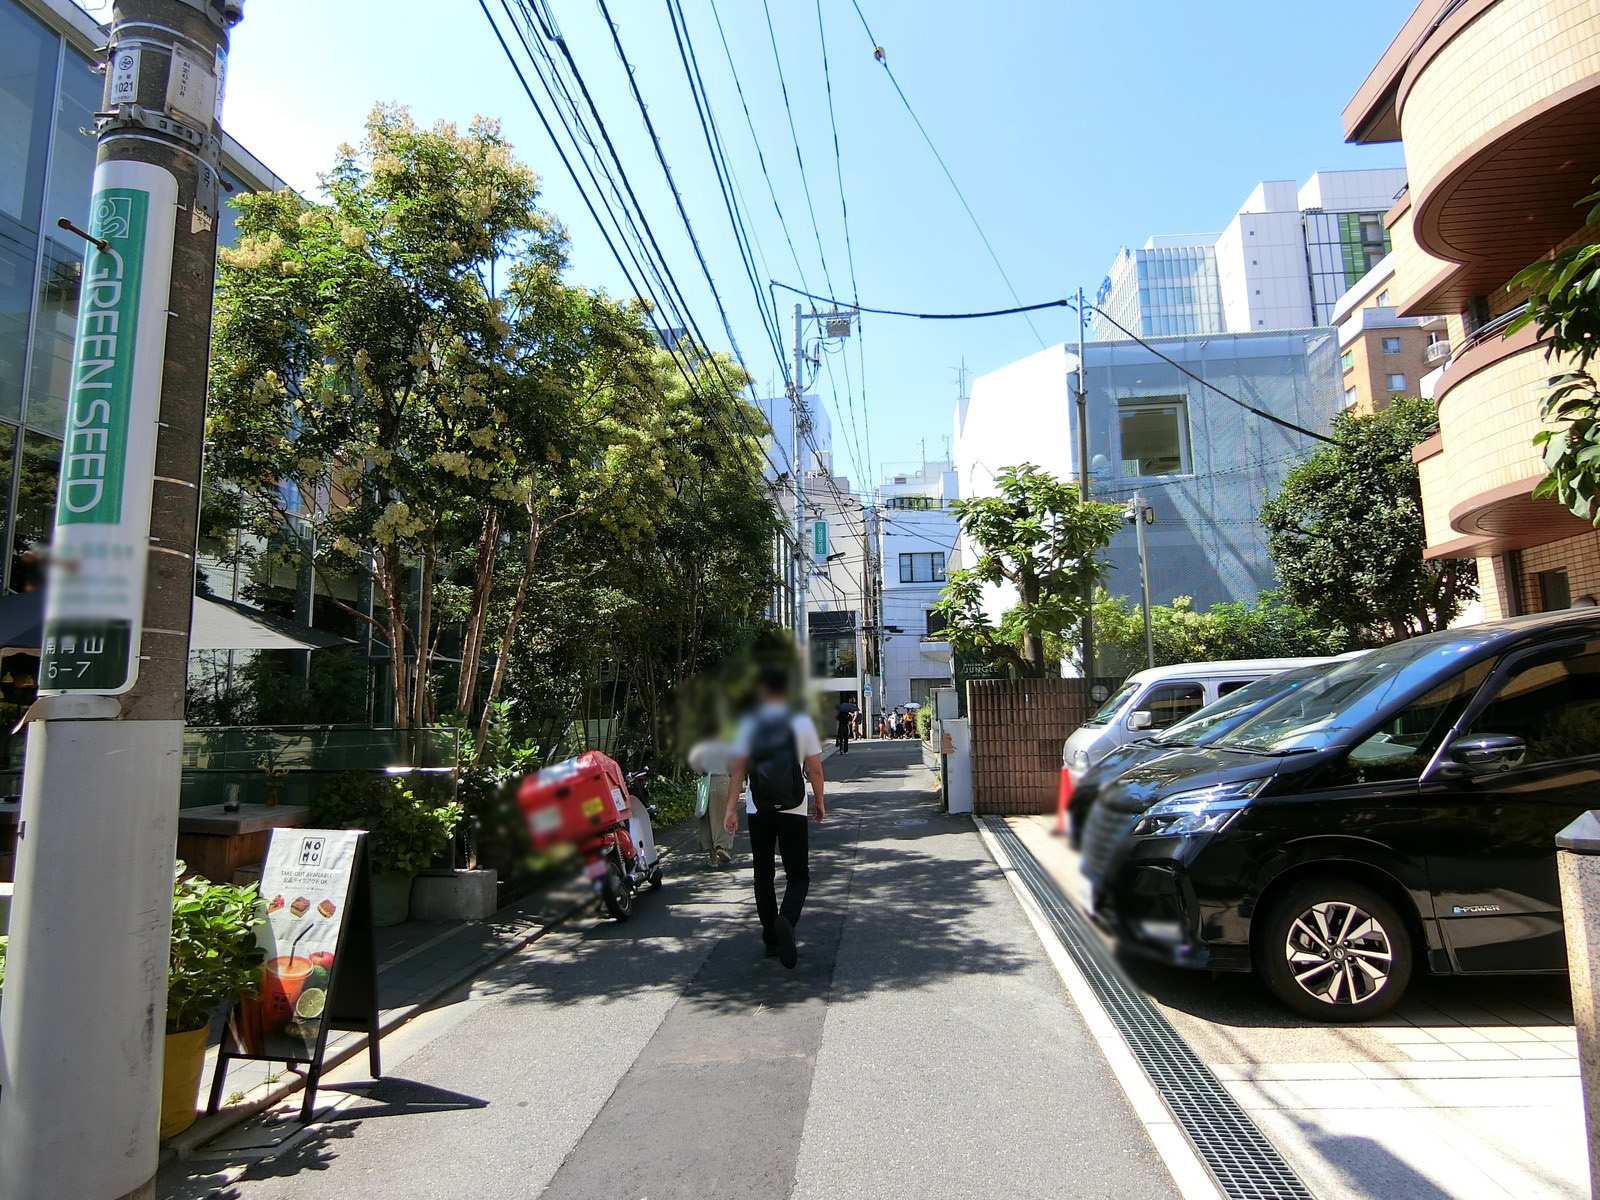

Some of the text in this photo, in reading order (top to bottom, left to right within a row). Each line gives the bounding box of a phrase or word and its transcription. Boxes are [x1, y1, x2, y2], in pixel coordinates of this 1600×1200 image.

[114, 81, 133, 93] 1021
[76, 247, 124, 391] GREEN
[65, 399, 111, 513] SEED
[304, 841, 321, 850] NO
[302, 852, 319, 862] MU
